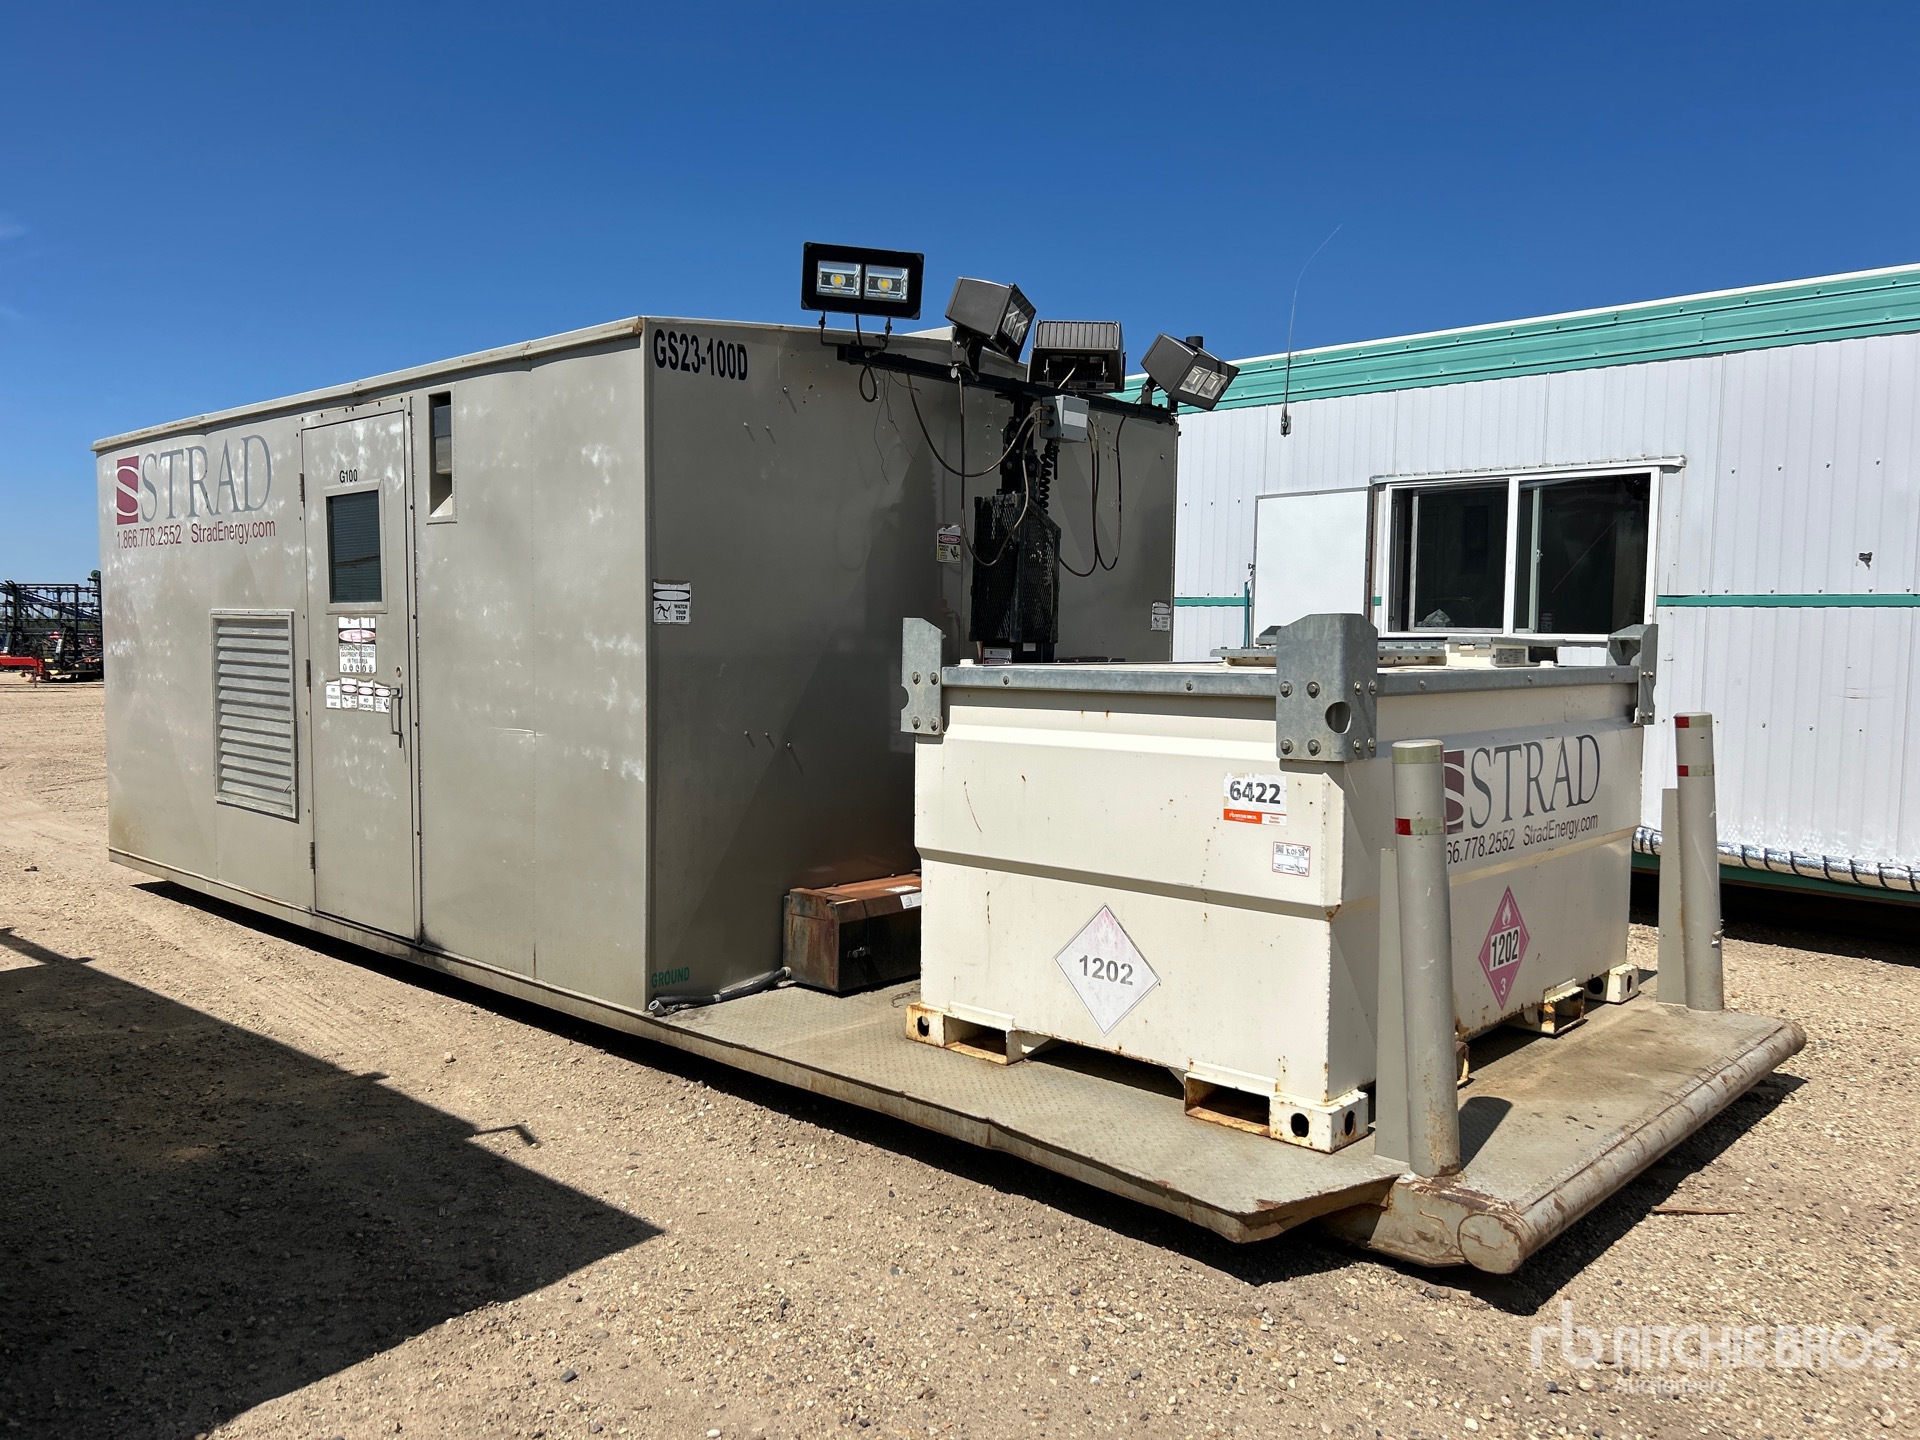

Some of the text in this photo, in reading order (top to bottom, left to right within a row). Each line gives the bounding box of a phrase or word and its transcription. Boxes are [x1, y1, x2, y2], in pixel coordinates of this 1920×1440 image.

[653, 328, 748, 381] GS23-100D
[140, 435, 272, 522] STRAD
[339, 469, 358, 483] G100
[116, 520, 276, 549] 1.866.778.2552 StradEnergy.com
[1230, 780, 1281, 805] 6422
[1469, 734, 1601, 829] STRAD
[1522, 814, 1599, 846] StradEnergy.com
[1491, 929, 1519, 968] 1202
[651, 966, 690, 989] GROUND
[1079, 955, 1134, 986] 1202
[1500, 977, 1506, 996] 3
